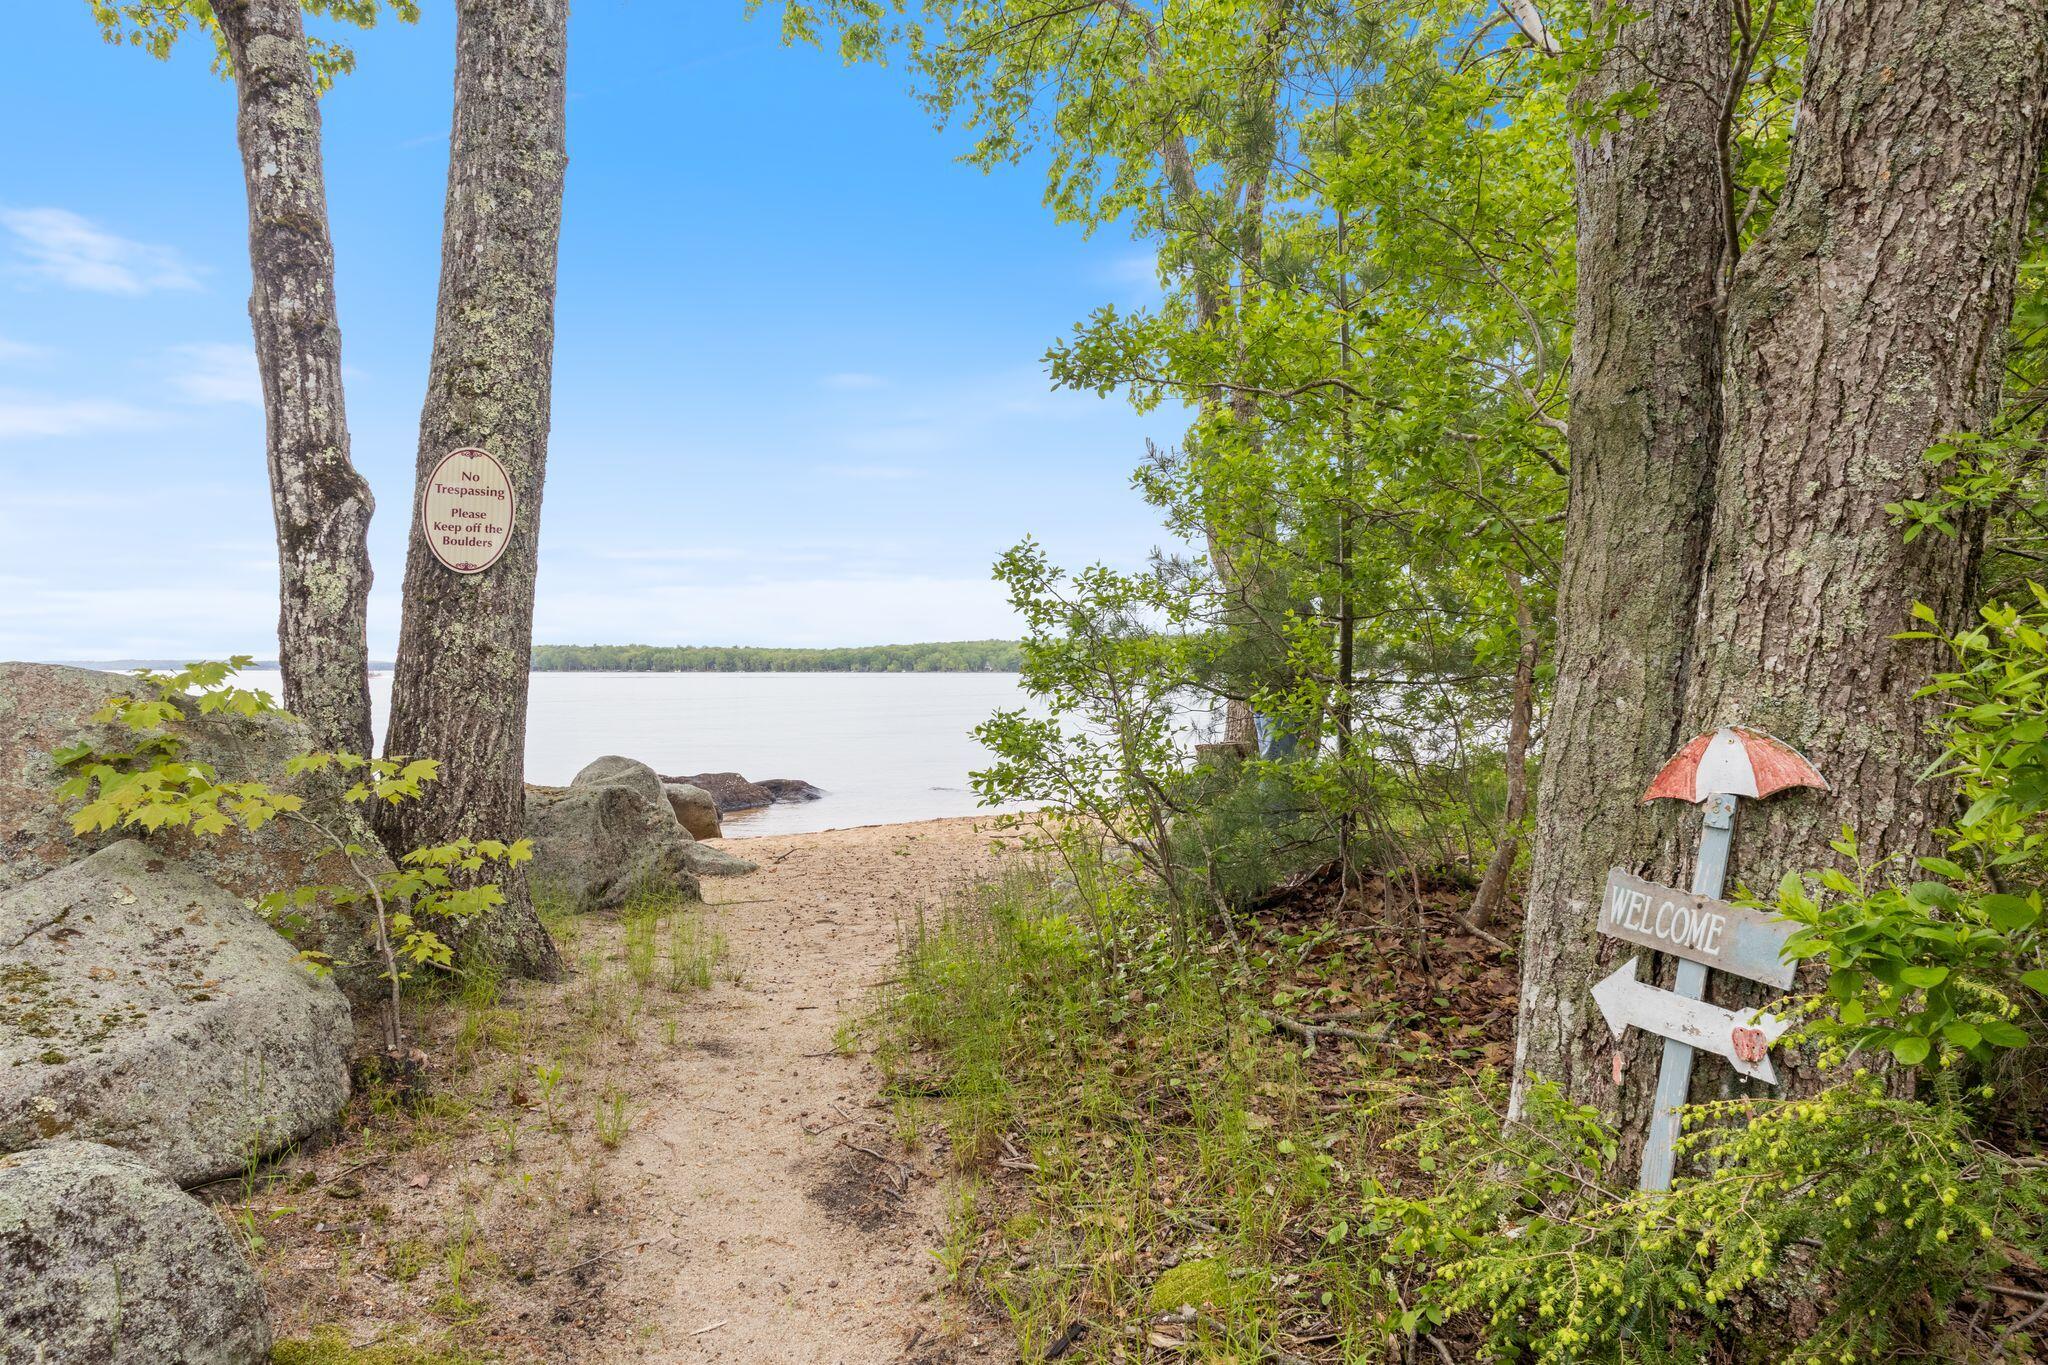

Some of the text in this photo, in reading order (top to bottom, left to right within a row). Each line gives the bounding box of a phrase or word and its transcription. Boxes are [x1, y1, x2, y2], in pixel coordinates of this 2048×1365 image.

[461, 471, 480, 482] No
[435, 483, 505, 500] Trespassing
[451, 508, 487, 519] Please
[433, 521, 503, 534] Keep off the
[442, 536, 493, 548] Boulders
[1610, 885, 1726, 956] WELCOME
